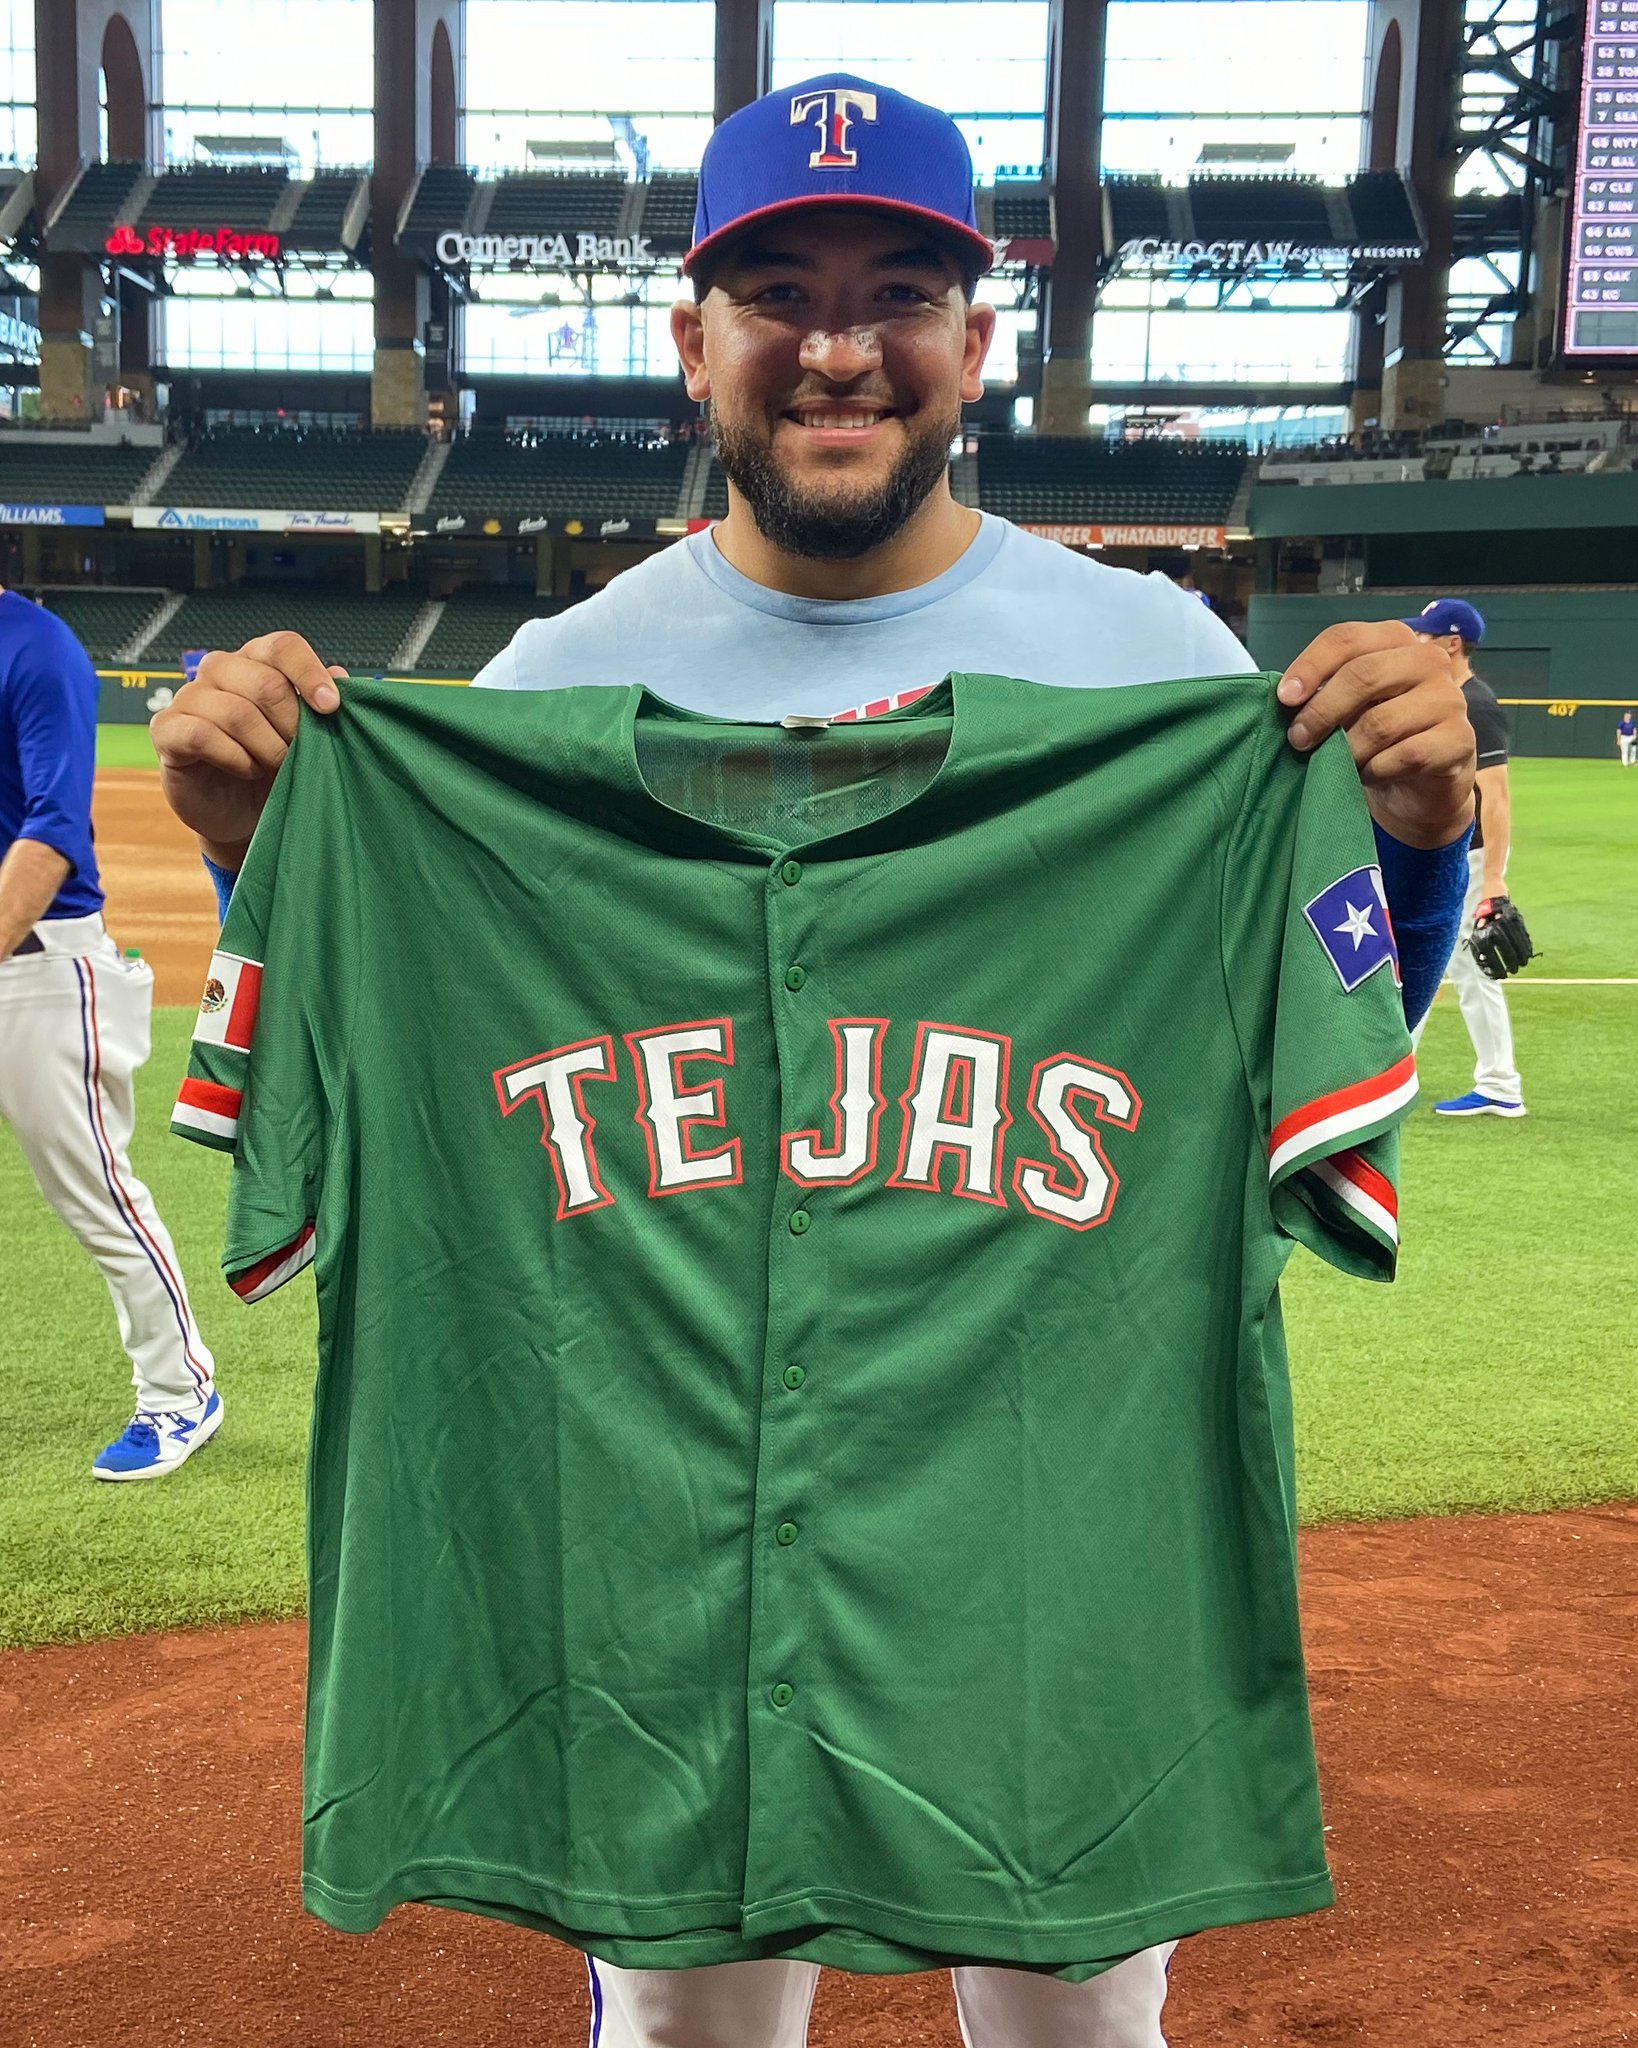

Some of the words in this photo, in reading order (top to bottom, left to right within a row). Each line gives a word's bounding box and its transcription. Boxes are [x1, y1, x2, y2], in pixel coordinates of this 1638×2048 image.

[791, 89, 877, 169] T
[576, 231, 652, 261] Bank
[1363, 246, 1422, 259] RESORTS
[186, 511, 259, 529] Albertsons
[1101, 526, 1218, 546] WHATABURGER
[1547, 703, 1578, 717] 407
